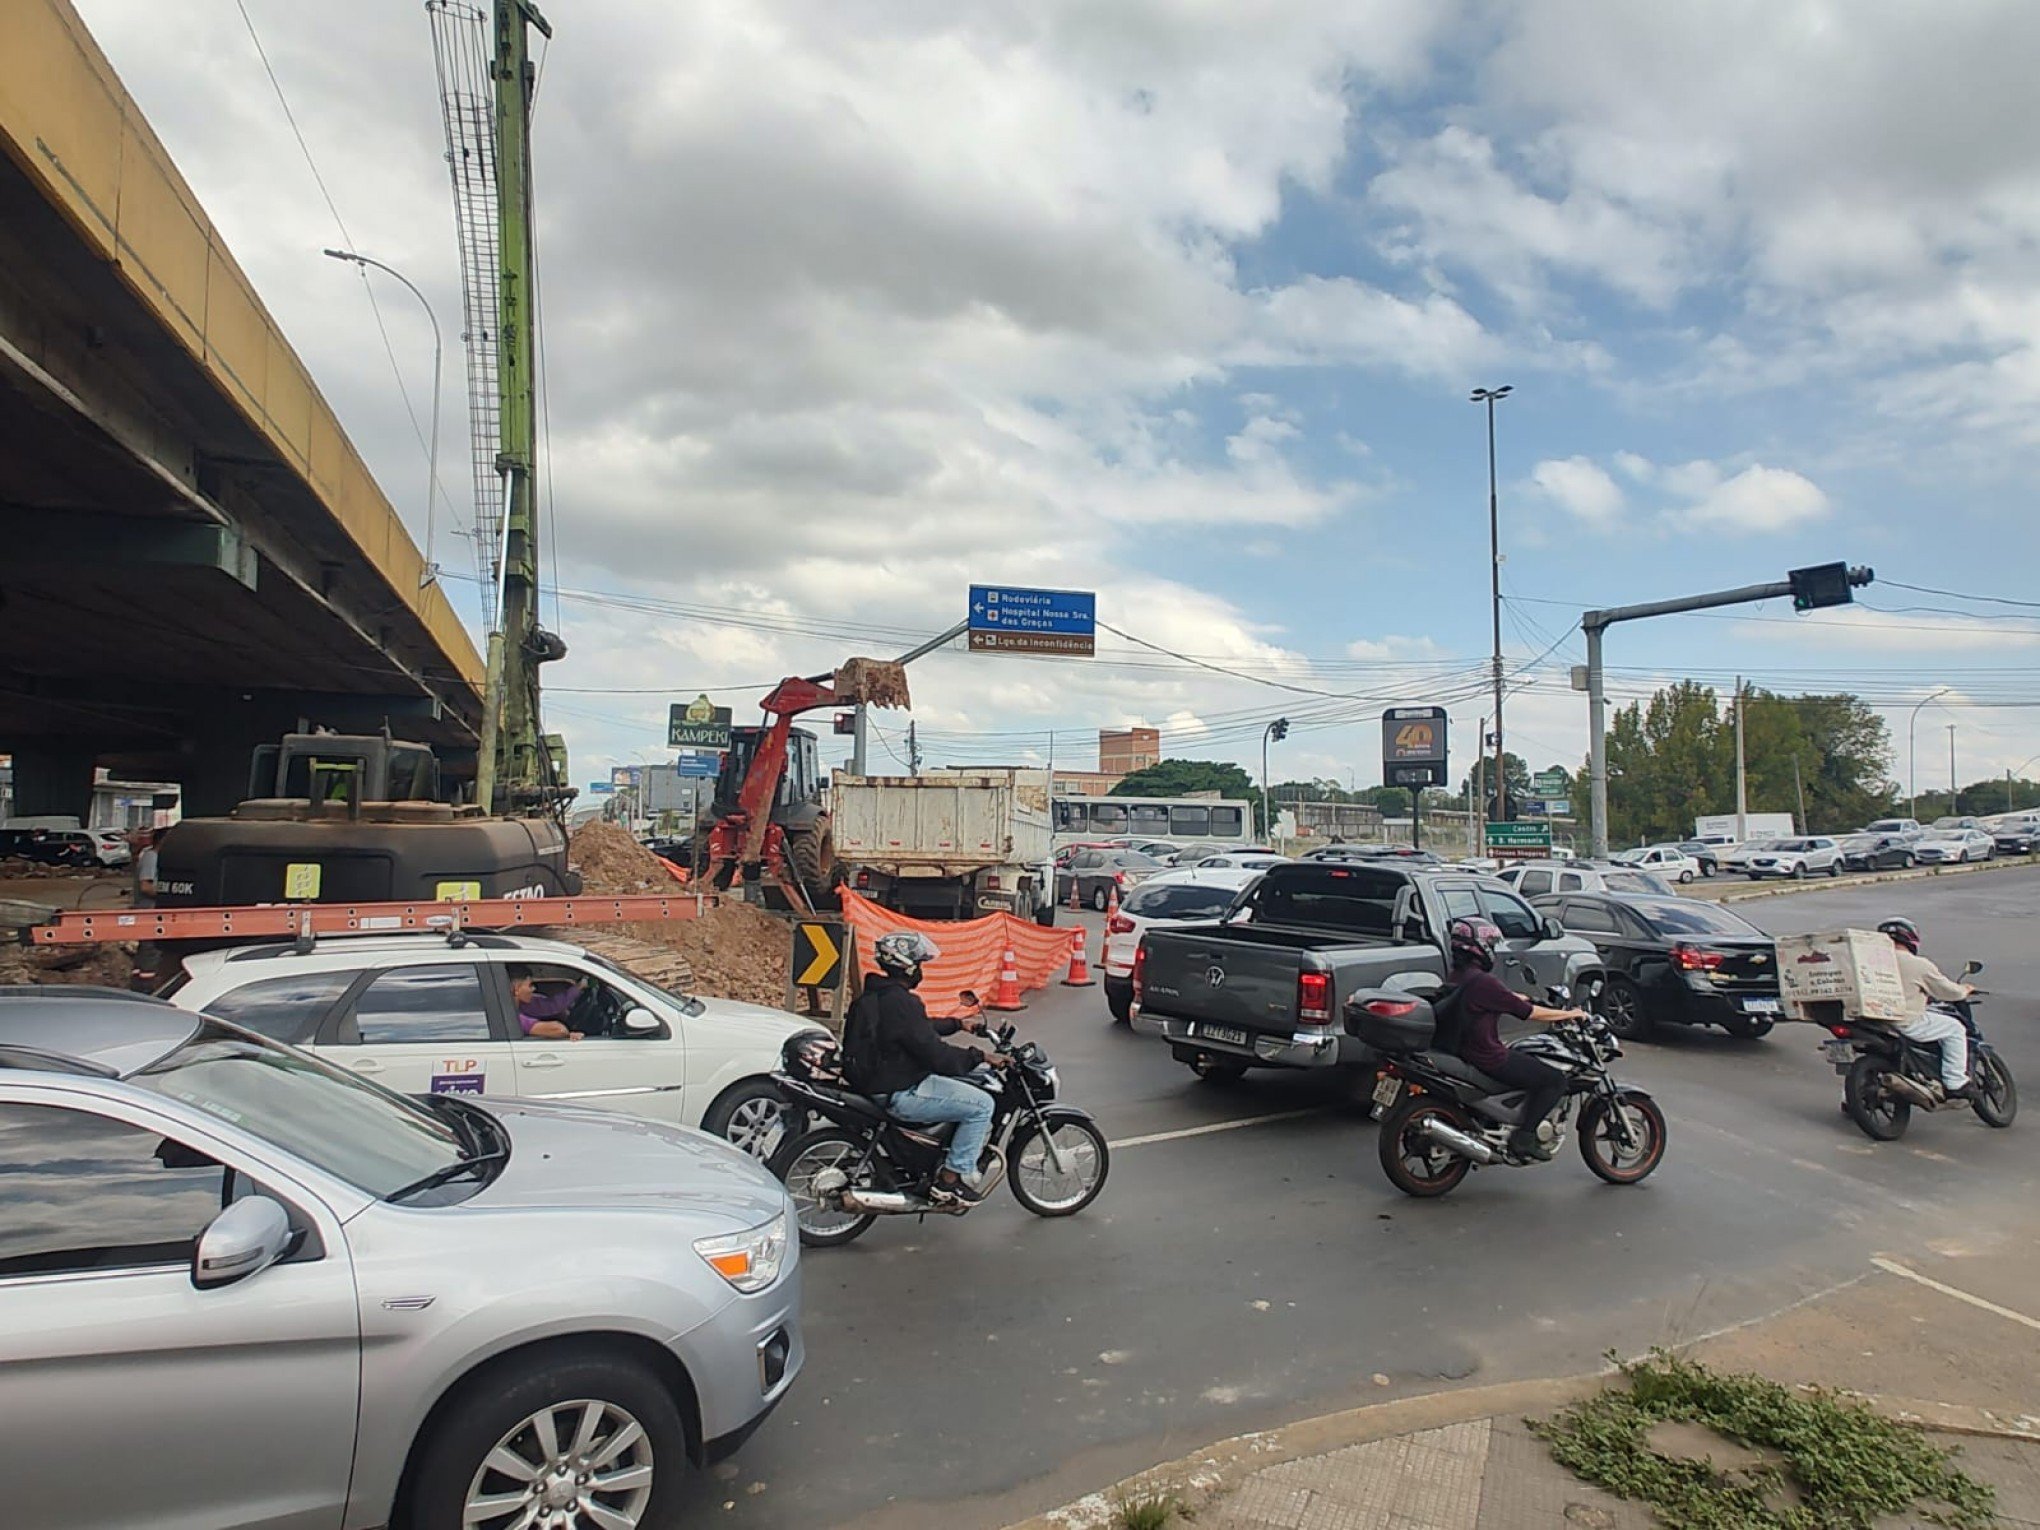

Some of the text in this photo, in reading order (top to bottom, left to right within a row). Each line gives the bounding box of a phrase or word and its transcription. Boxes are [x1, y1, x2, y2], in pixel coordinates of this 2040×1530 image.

[1002, 594, 1051, 605] Rodoviária
[1002, 607, 1040, 618] Hospital
[1043, 609, 1069, 619] Nossa
[1002, 618, 1053, 628] das Graças
[1017, 637, 1028, 646] da
[1030, 639, 1093, 650] Inconfidência
[671, 727, 729, 744] KAMPEKI
[1395, 724, 1433, 749] 40
[442, 1060, 477, 1072] TLP
